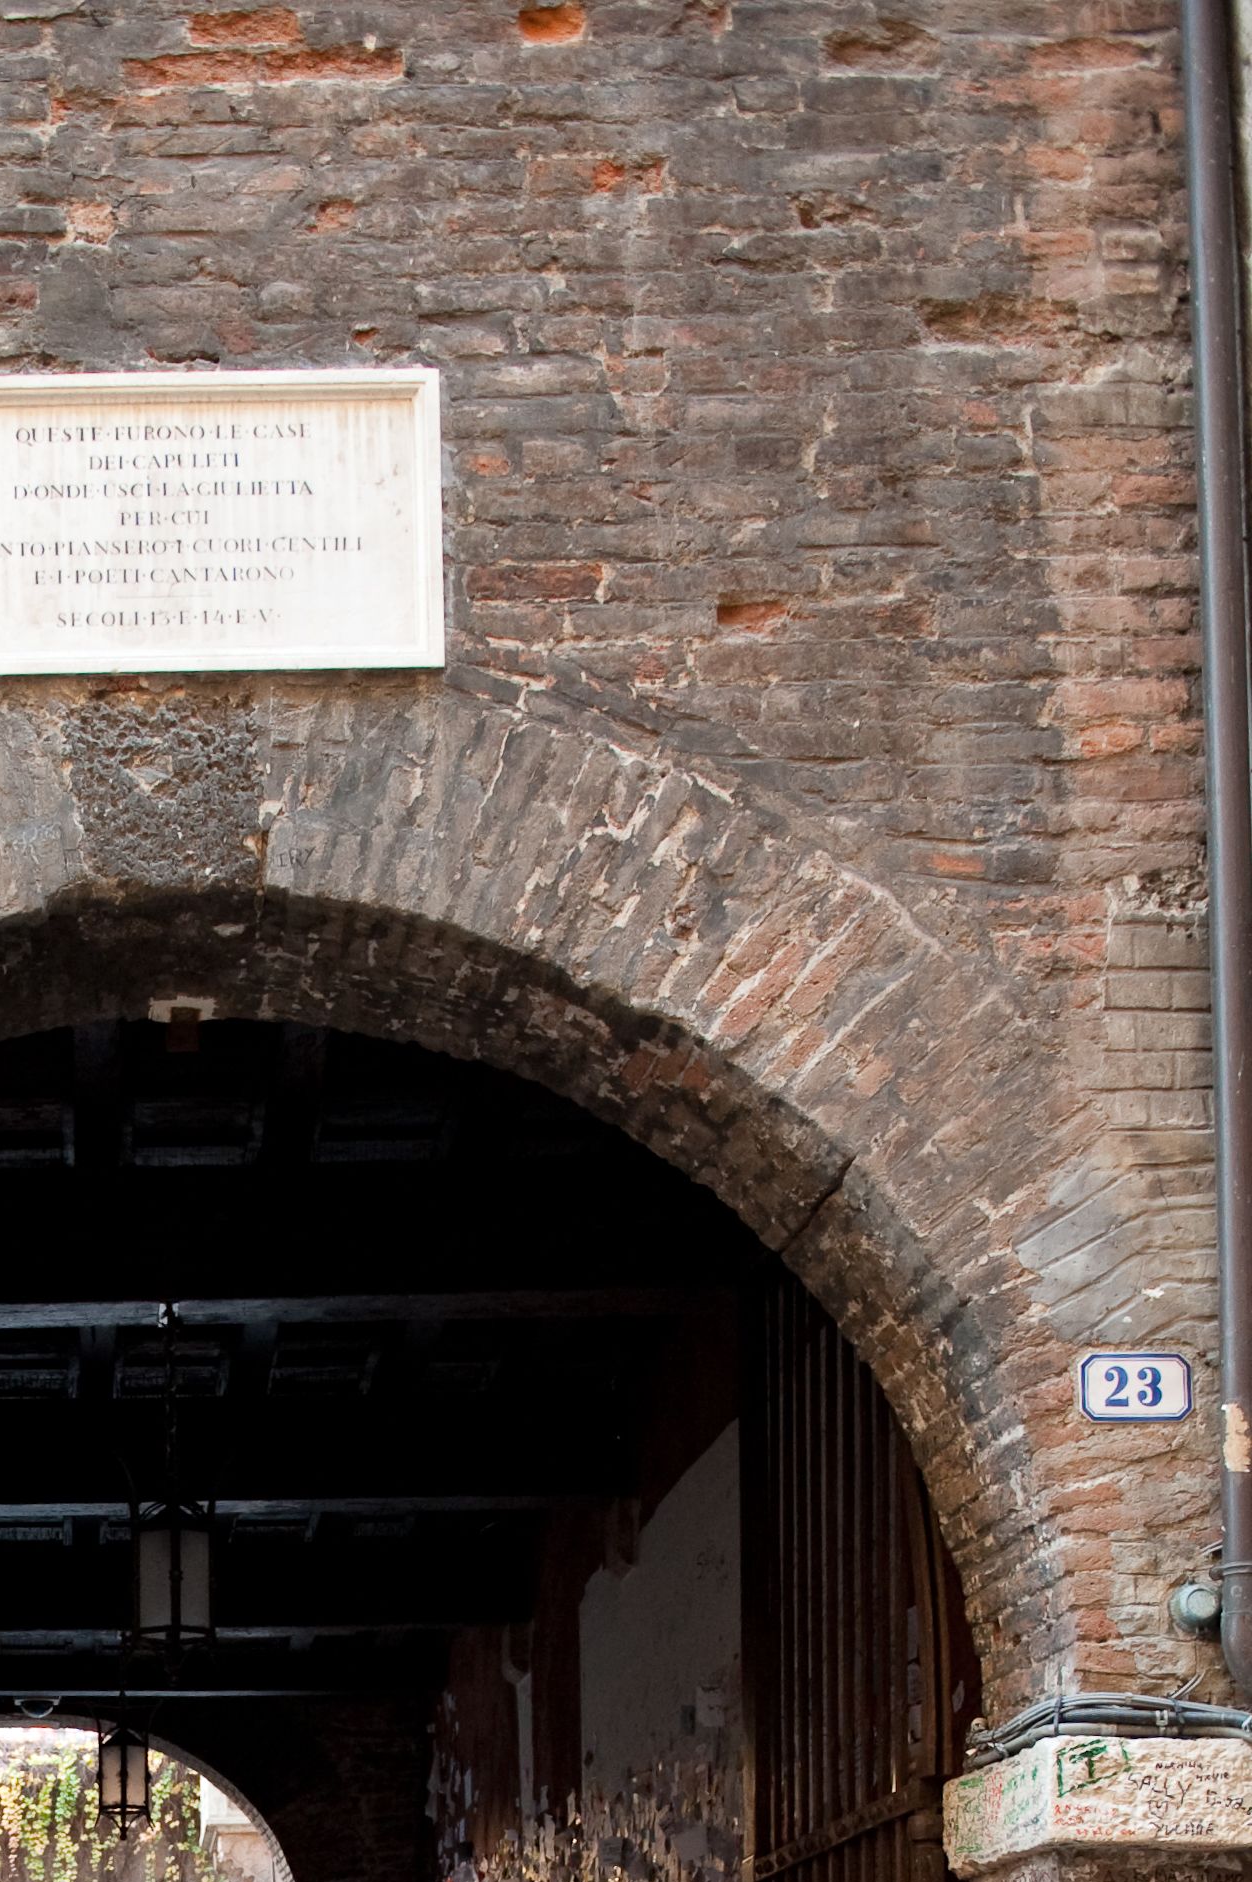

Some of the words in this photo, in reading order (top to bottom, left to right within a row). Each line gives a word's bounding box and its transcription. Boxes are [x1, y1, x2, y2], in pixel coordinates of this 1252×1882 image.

[15, 427, 102, 446] QUESTE
[114, 424, 205, 442] FURONO
[216, 424, 242, 439] LE
[253, 423, 311, 439] CASE
[89, 456, 124, 470] DEI
[132, 453, 240, 470] CAPULETI
[162, 482, 190, 497] LA
[197, 480, 314, 497] GIULIETTA
[119, 512, 162, 526] PER
[172, 510, 209, 525] CUI
[54, 540, 168, 556] PIANSERO
[193, 537, 261, 554] CUORI
[271, 536, 363, 551] GENTILI
[34, 570, 46, 585] E
[57, 569, 63, 583] I
[75, 568, 140, 584] POETI
[150, 566, 295, 583] CANTARONO
[56, 610, 141, 628] SECOLI
[180, 610, 192, 625] E
[203, 610, 225, 625] 14
[236, 609, 248, 623] E
[1104, 1365, 1163, 1407] 23
